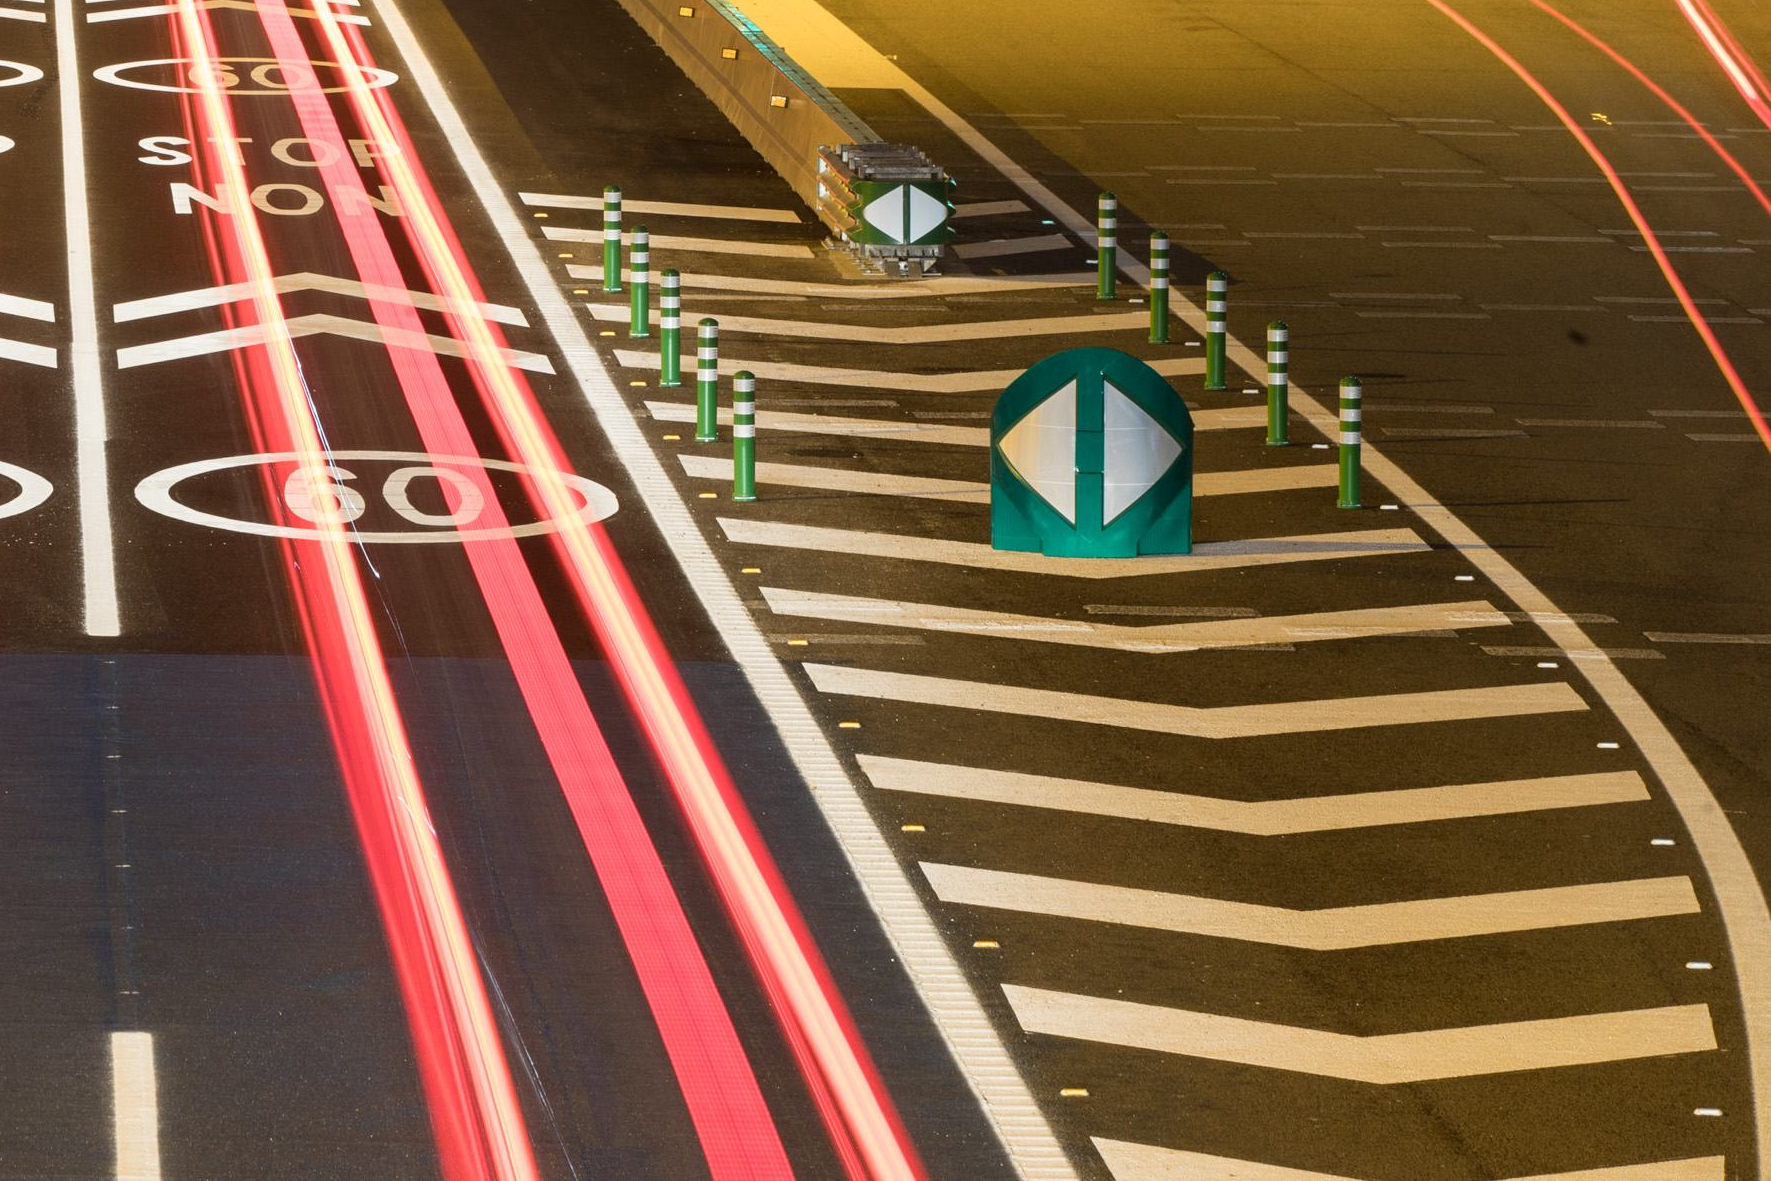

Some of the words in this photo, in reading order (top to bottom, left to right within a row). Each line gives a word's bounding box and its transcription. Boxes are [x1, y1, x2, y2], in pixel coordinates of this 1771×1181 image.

[187, 63, 314, 89] 60
[137, 135, 401, 169] STOP
[169, 182, 409, 217] NON
[283, 465, 485, 527] 60
